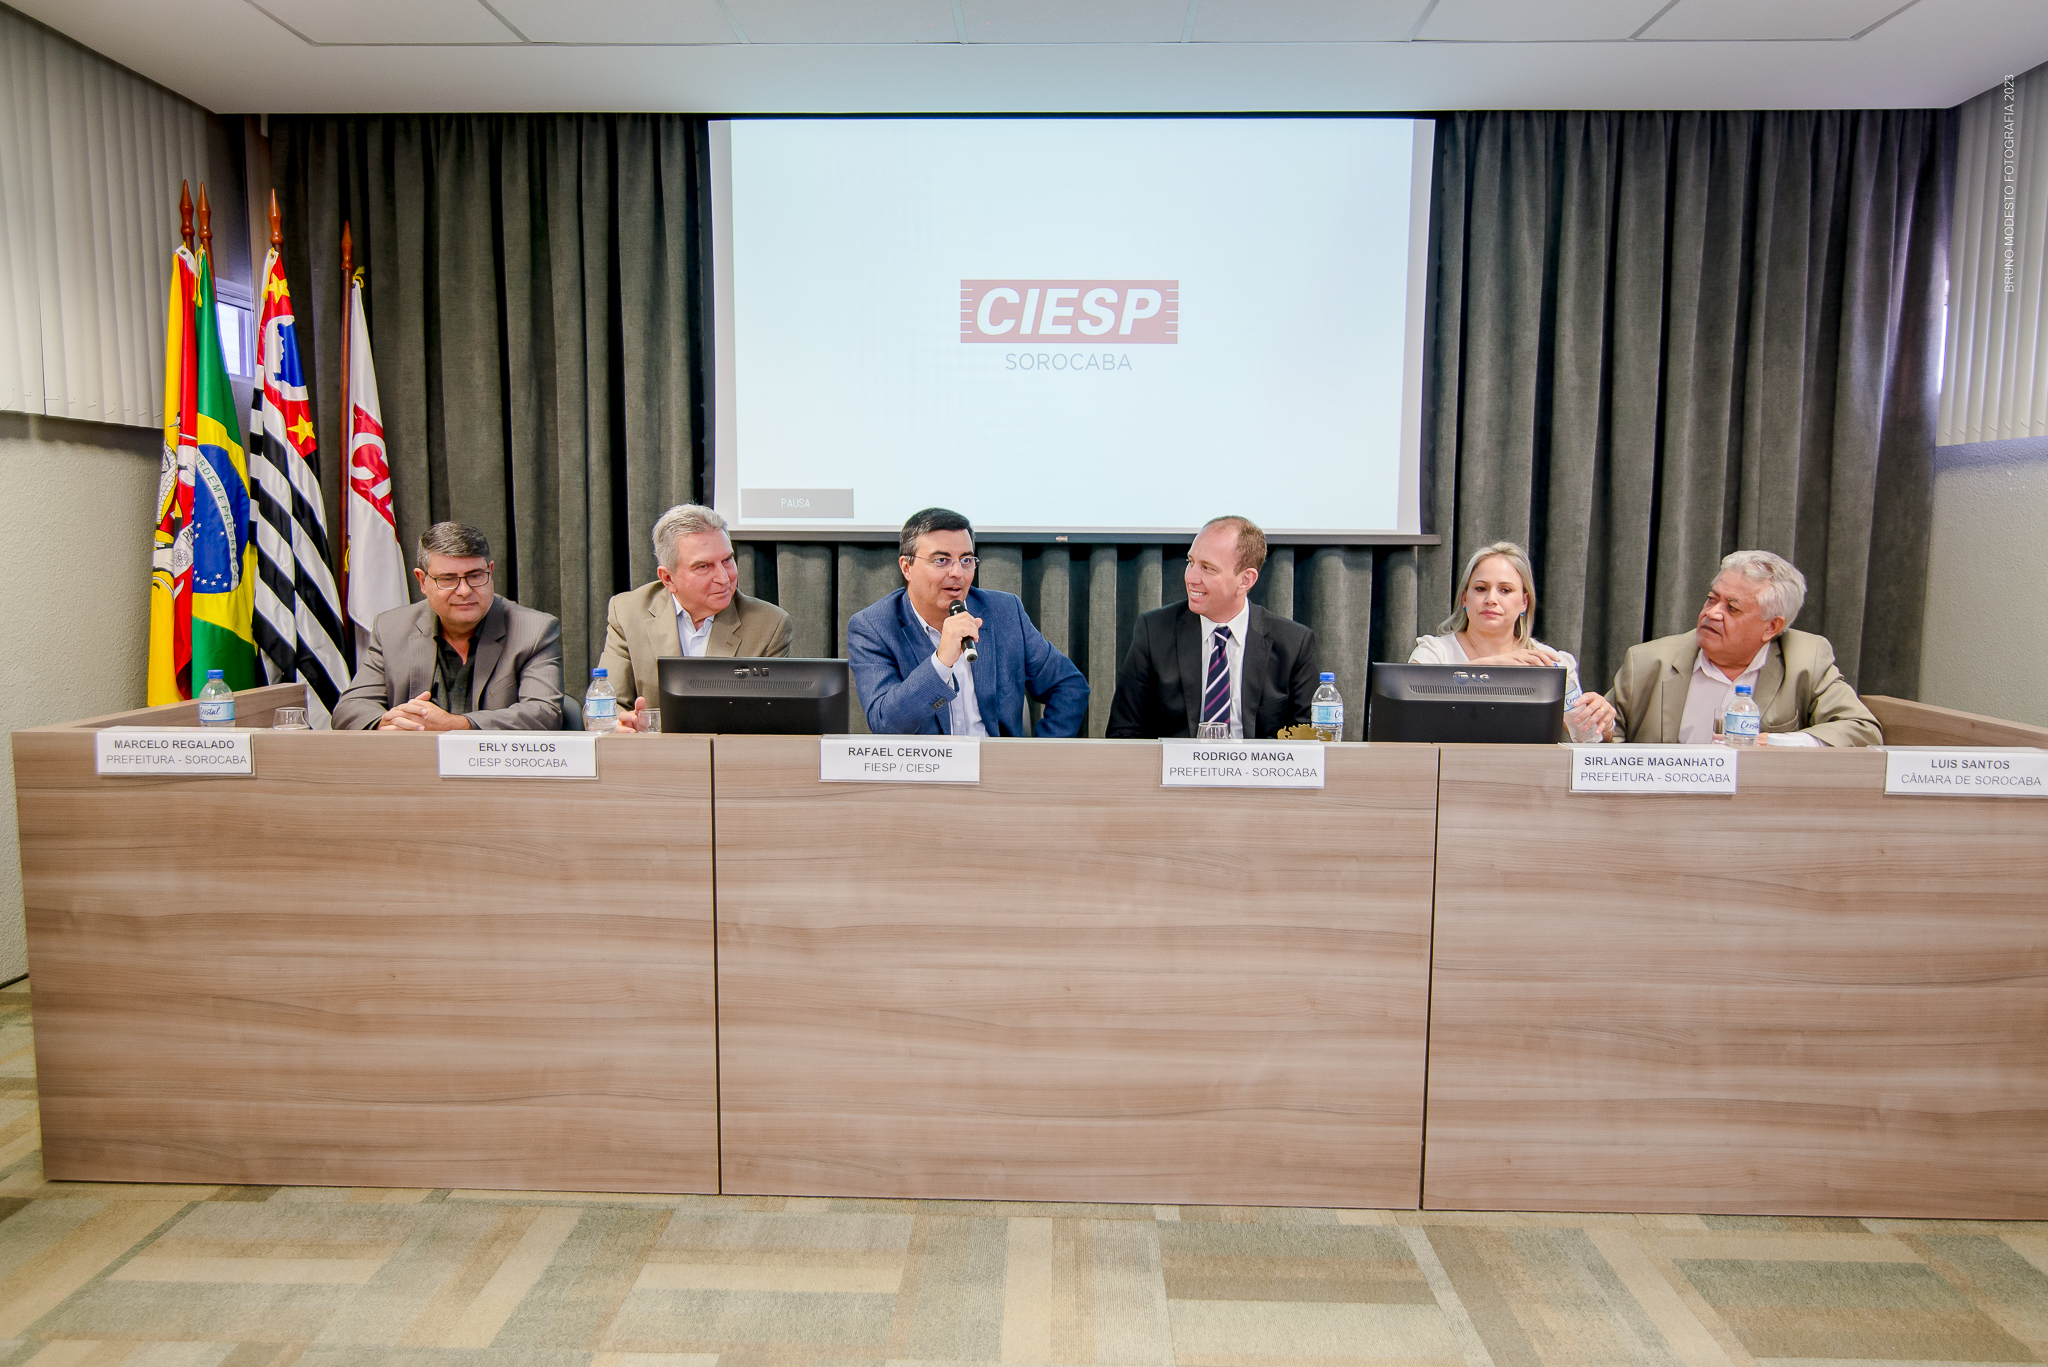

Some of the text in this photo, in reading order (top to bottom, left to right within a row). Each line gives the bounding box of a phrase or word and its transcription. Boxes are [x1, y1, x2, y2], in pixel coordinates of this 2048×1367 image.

[976, 287, 1163, 336] CIESP
[1005, 353, 1132, 370] SOROCABA
[780, 498, 811, 508] PAUSA
[114, 740, 235, 749] MARCELO REGALADO
[479, 743, 556, 752] ERLY SYLLOS
[848, 747, 953, 758] RAFAEL CERVONE
[1193, 751, 1294, 761] RODRIGO MANGA
[106, 755, 175, 764] PREFEITURA
[185, 755, 247, 764] SOROCABA
[468, 758, 568, 768] CIESP SOROCABA
[1584, 756, 1724, 767] SIRLANGE MAGANHATO
[1931, 759, 2010, 769] LUIS SANTOS
[864, 762, 897, 772] FIESP
[906, 763, 940, 773] CIESP
[1169, 767, 1242, 777] PREFEITURA
[1252, 768, 1317, 777] SOROCABA
[1580, 772, 1654, 782] PREFEITURA
[1664, 773, 1731, 783] SOROCABA
[1901, 772, 2042, 786] CÂMARA DE SOROCABA
